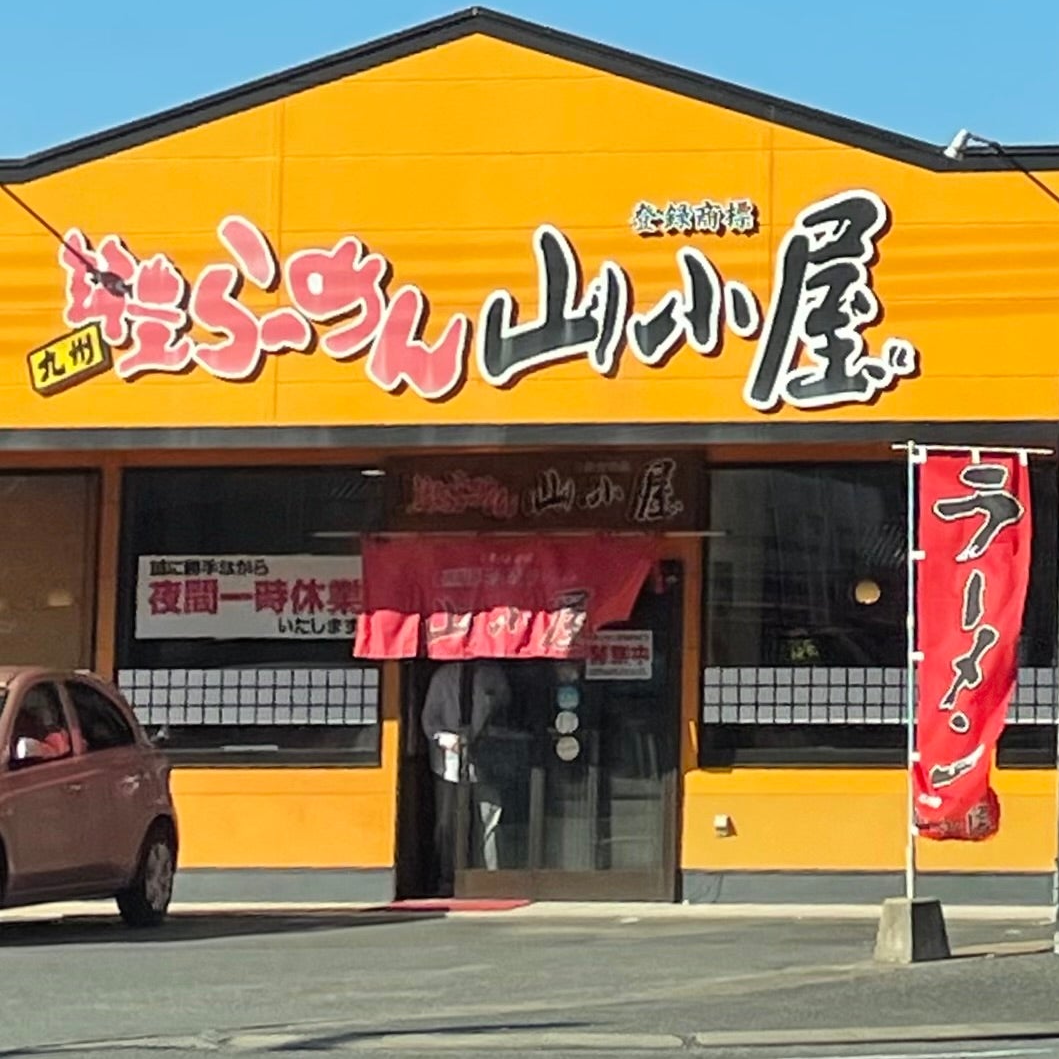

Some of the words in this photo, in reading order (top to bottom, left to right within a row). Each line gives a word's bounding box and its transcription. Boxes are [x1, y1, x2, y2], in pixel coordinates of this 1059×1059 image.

[37, 332, 95, 383] 九州
[476, 189, 916, 411] 山小屋
[147, 578, 363, 615] 夜間一時休業
[929, 462, 1026, 789] ラーメン
